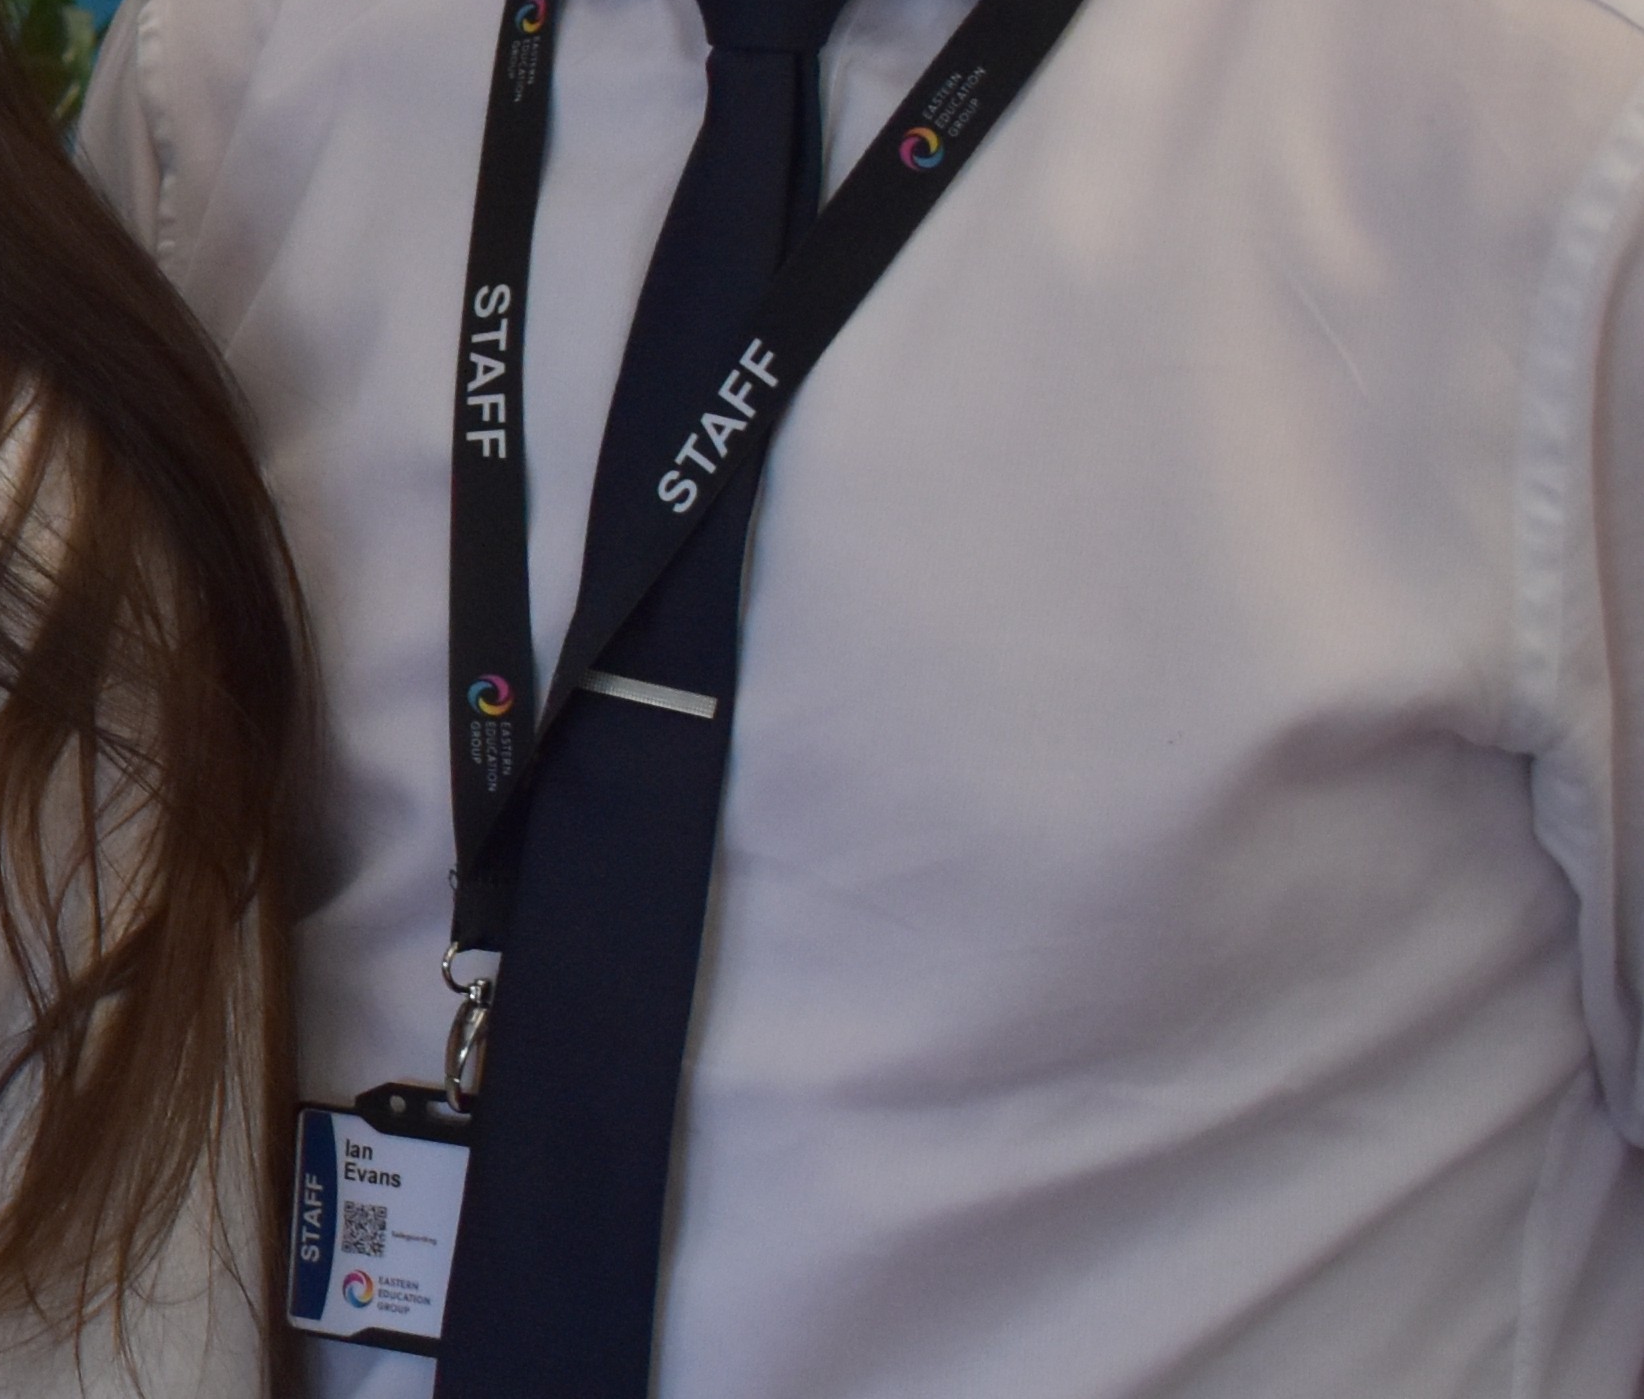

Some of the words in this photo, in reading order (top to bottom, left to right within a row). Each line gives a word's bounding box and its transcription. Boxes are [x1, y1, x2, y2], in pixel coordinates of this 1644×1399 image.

[922, 72, 963, 120] EASTERN
[934, 66, 987, 129] EDUCATION
[467, 283, 511, 460] STAFF
[656, 338, 784, 514] STAFF
[470, 721, 483, 765] GROUP
[485, 721, 498, 793] EDUCATION
[499, 721, 512, 776] EASTERN
[345, 1138, 373, 1161] Ian
[344, 1162, 402, 1188] Evans
[301, 1173, 323, 1263] STAFF
[378, 1275, 419, 1291] EASTERN
[378, 1289, 431, 1306] EDUCATION
[377, 1301, 411, 1315] GROUP
